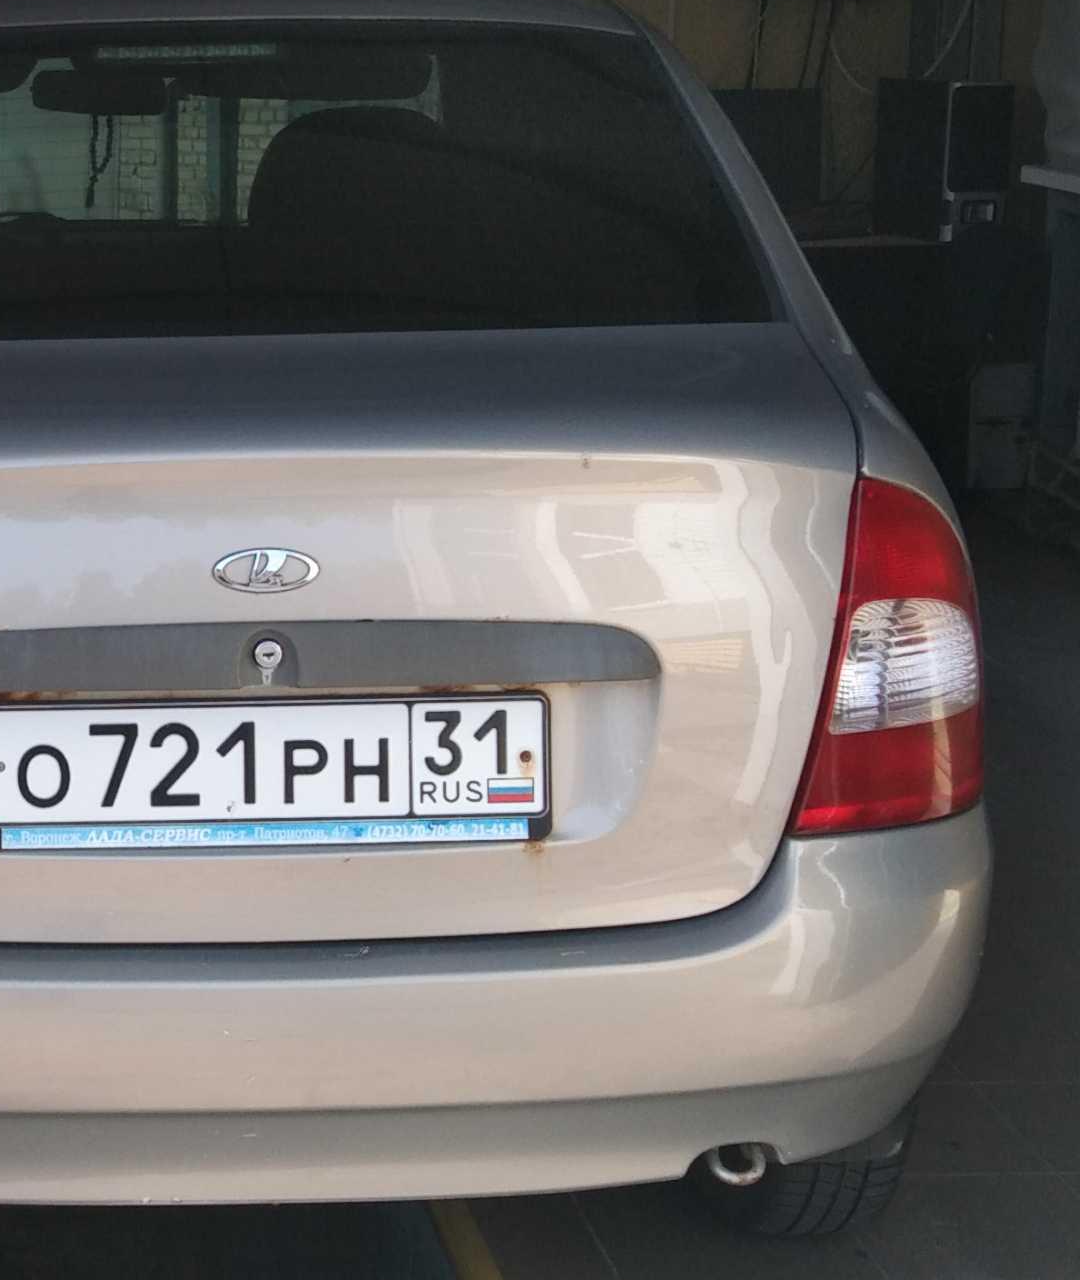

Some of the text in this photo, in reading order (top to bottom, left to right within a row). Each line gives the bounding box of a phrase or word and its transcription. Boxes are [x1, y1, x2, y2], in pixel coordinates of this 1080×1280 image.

[423, 708, 508, 776] 31
[420, 781, 483, 804] RUS
[86, 827, 212, 843] ЛАДА-СЕРВИС
